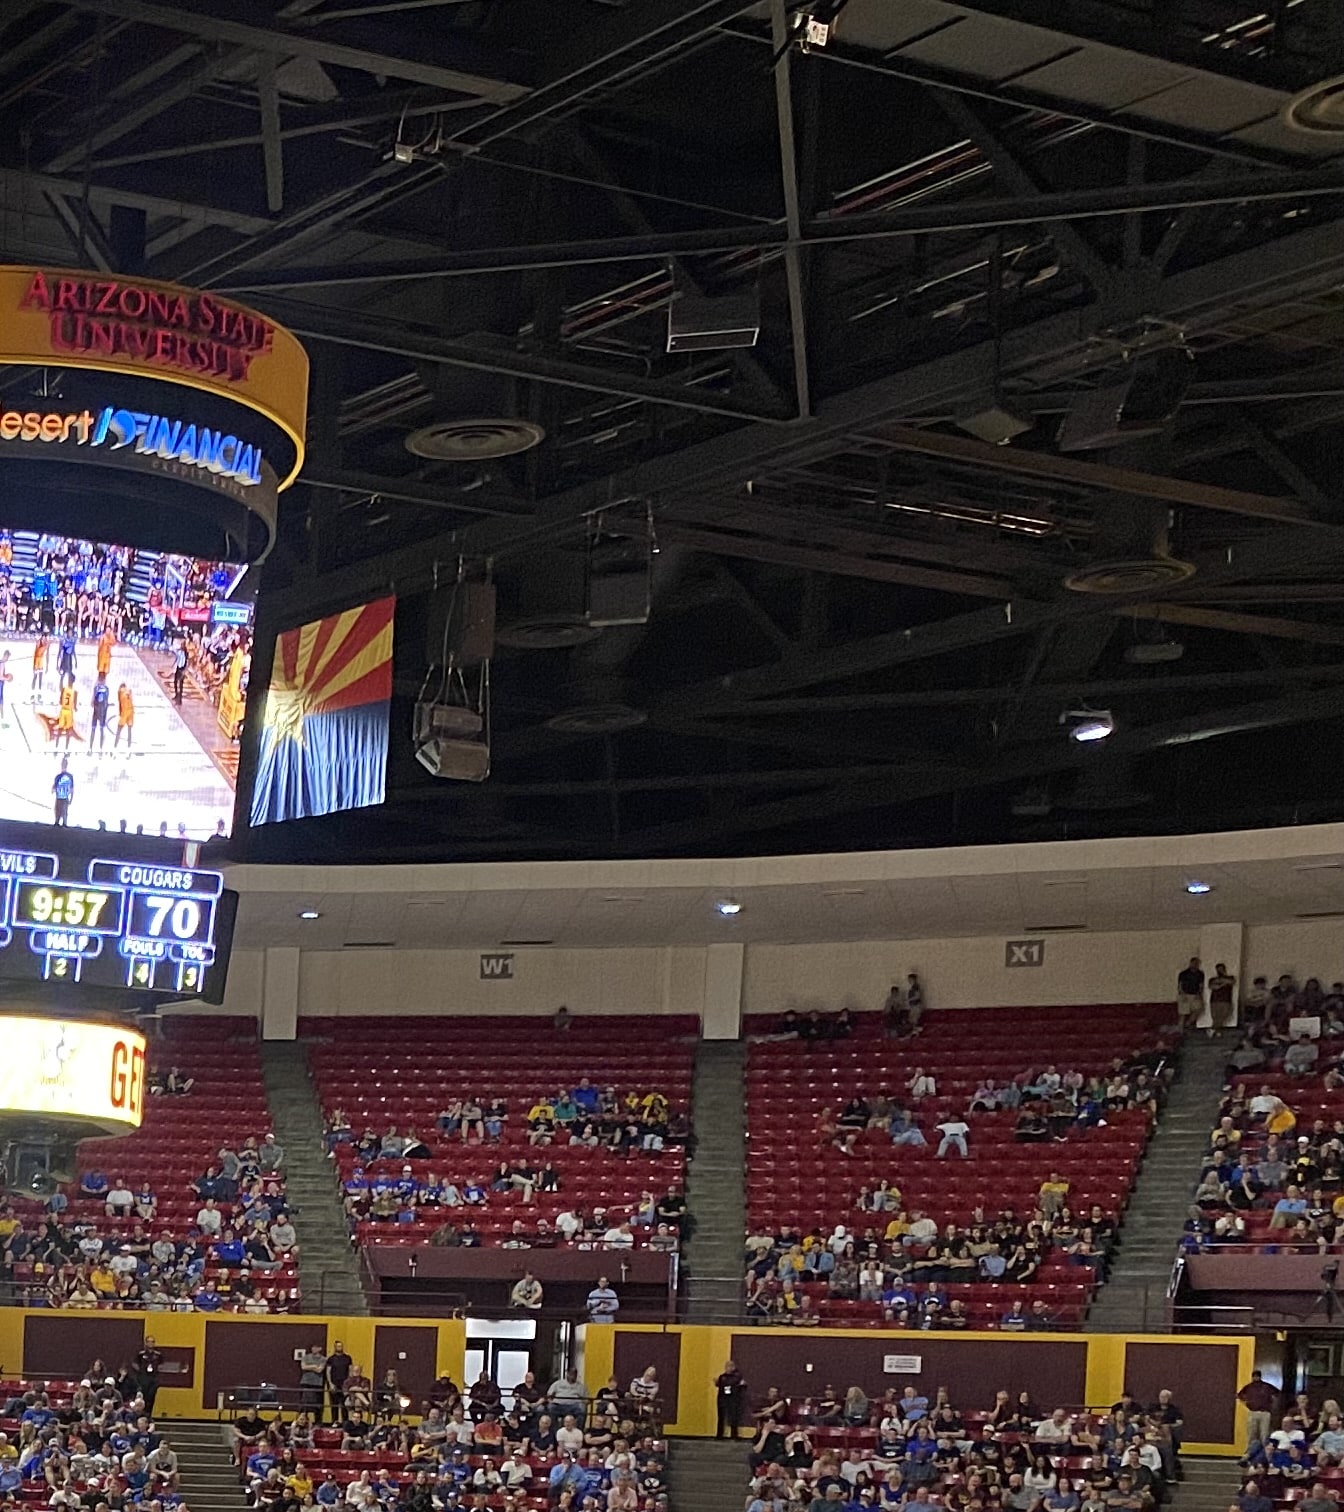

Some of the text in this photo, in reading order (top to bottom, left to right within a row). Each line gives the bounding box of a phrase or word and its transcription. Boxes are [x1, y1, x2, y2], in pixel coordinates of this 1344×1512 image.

[18, 271, 274, 353] ARIZONA STATE
[50, 313, 255, 381] UNIVERSITY
[133, 413, 262, 486] FINANCIAL
[120, 867, 193, 890] COUGARS
[31, 888, 109, 927] 9:57
[146, 896, 199, 938] 70
[46, 934, 87, 950] HALF
[123, 939, 164, 956] FOULS
[182, 944, 205, 960] TOL
[1011, 945, 1039, 962] X1
[54, 957, 67, 977] 2
[135, 963, 148, 984] 4
[482, 959, 513, 974] W1
[185, 968, 196, 987] 3
